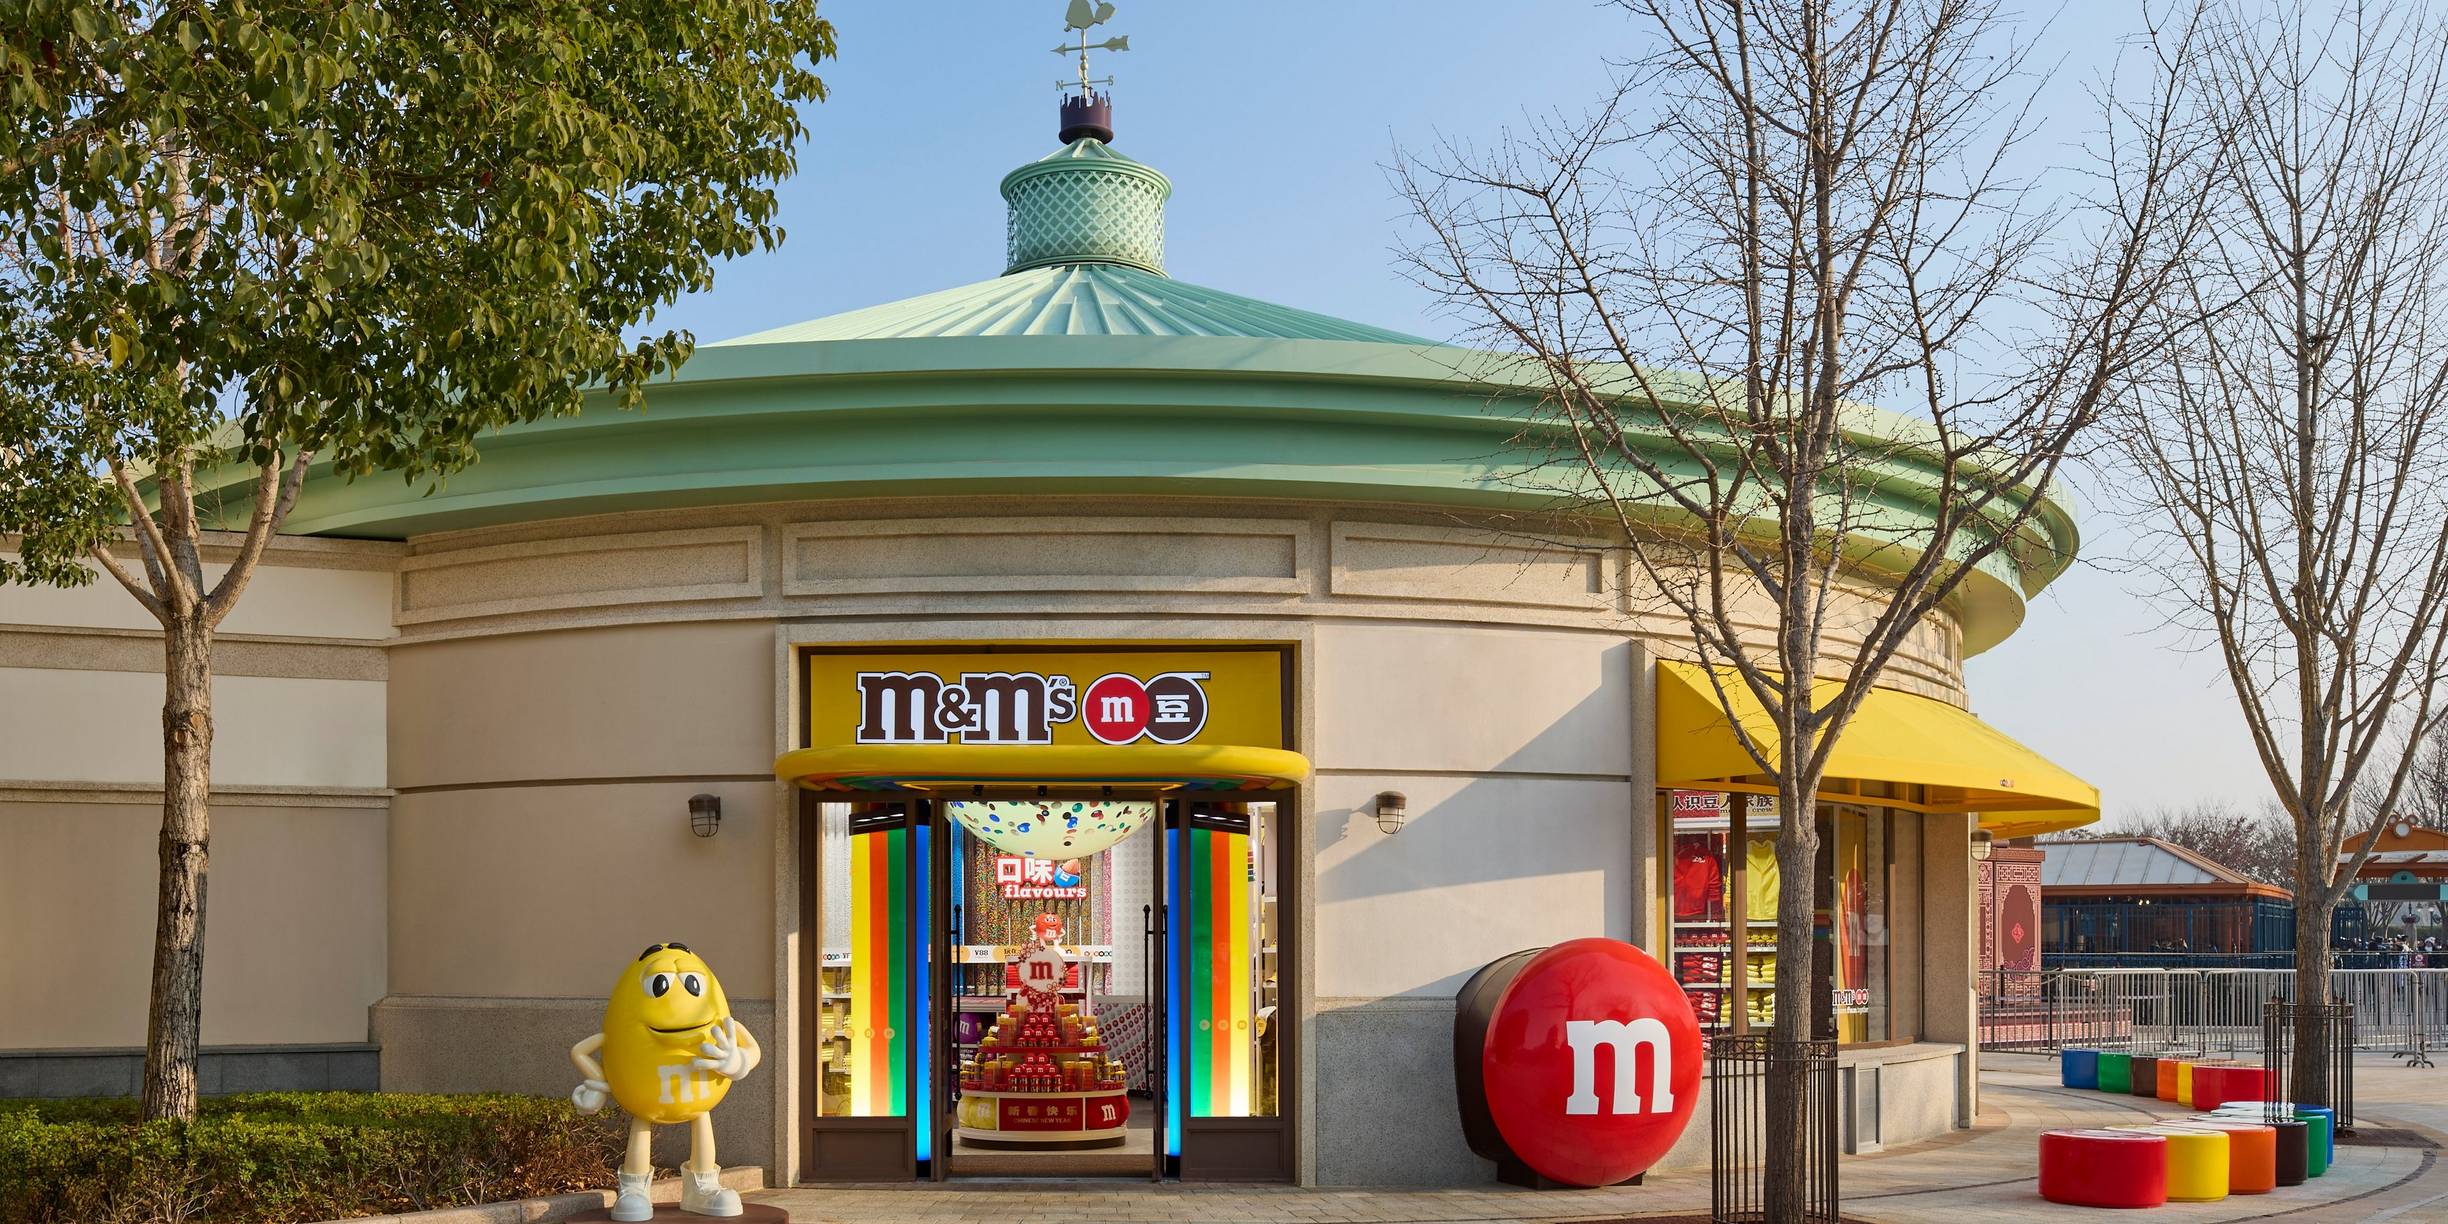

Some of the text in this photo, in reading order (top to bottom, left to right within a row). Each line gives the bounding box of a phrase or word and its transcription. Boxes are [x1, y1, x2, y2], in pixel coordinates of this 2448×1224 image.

[1056, 80, 1063, 91] N
[1100, 696, 1134, 723] m
[1155, 694, 1190, 723] 豆
[997, 858, 1053, 883] 口味
[1004, 885, 1087, 898] flavours
[1029, 961, 1054, 980] m
[1566, 1018, 1674, 1115] m
[1102, 1104, 1116, 1121] m
